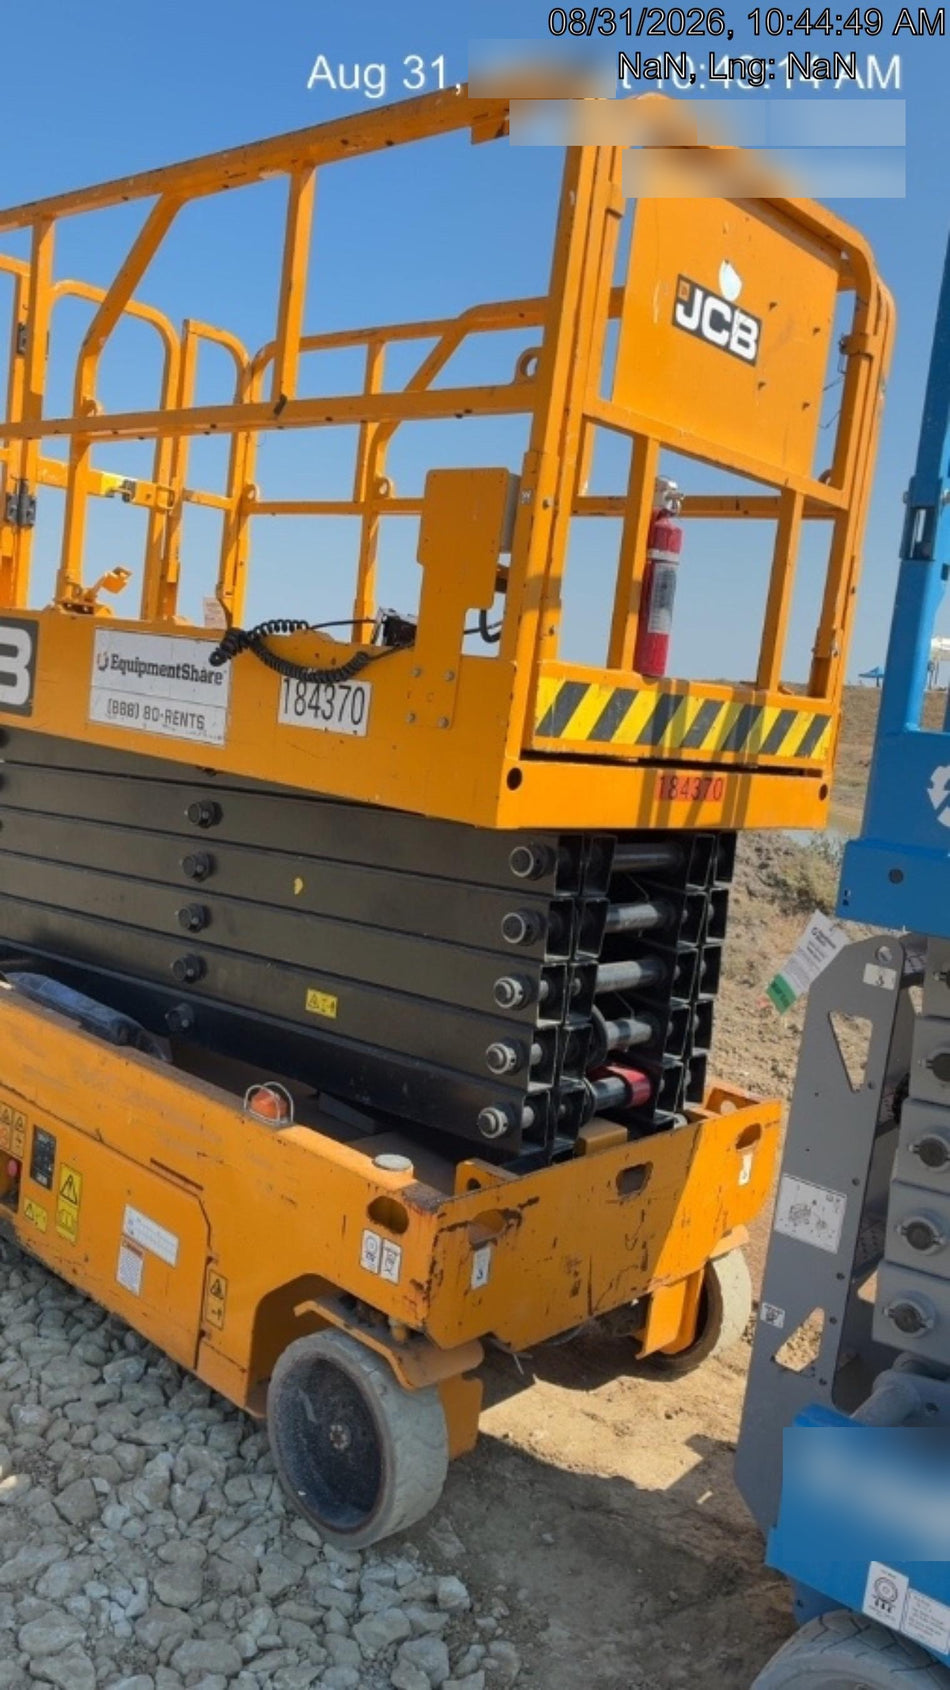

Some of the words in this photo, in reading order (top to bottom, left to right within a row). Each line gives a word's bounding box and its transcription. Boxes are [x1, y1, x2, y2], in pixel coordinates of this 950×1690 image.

[675, 287, 759, 361] JCB
[110, 653, 224, 686] EquipmentShare
[283, 679, 365, 725] 184370
[660, 775, 723, 801] 184370
